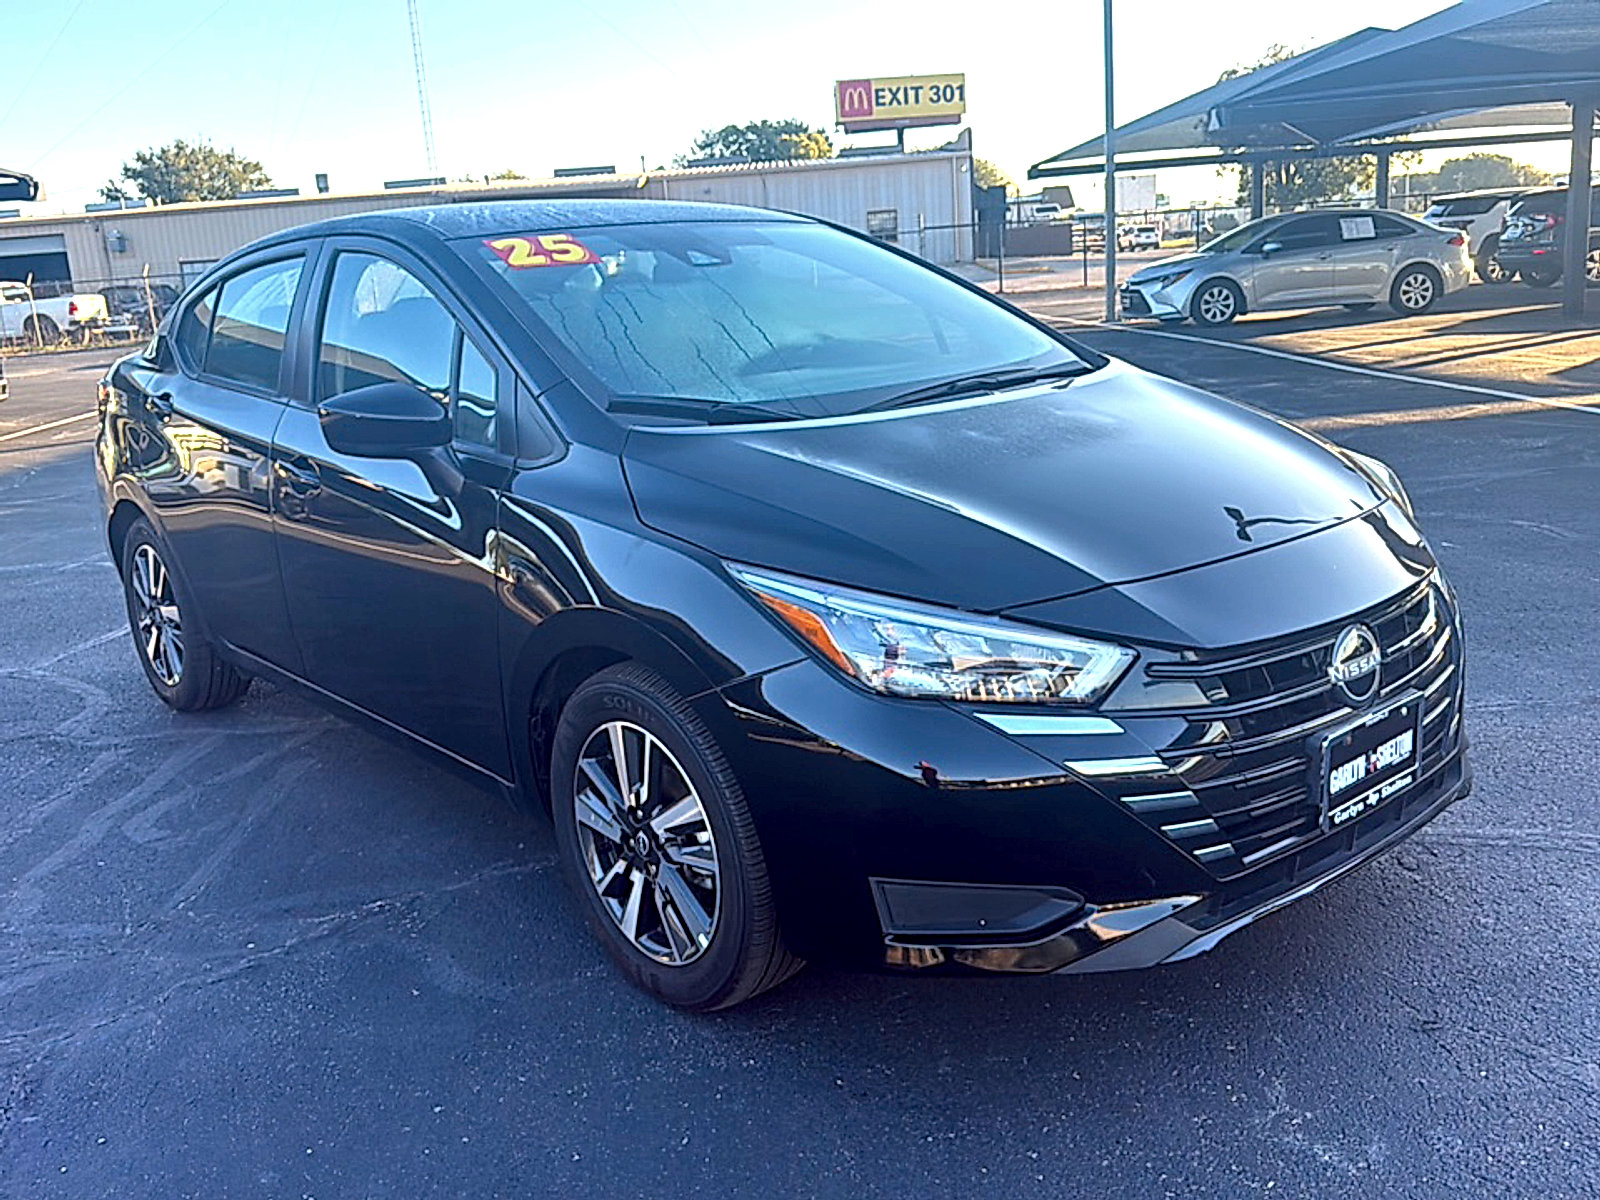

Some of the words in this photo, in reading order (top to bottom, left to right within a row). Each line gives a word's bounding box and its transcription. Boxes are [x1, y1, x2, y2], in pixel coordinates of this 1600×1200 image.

[874, 85, 924, 107] EXIT
[928, 83, 965, 104] 301
[490, 233, 590, 267] 25
